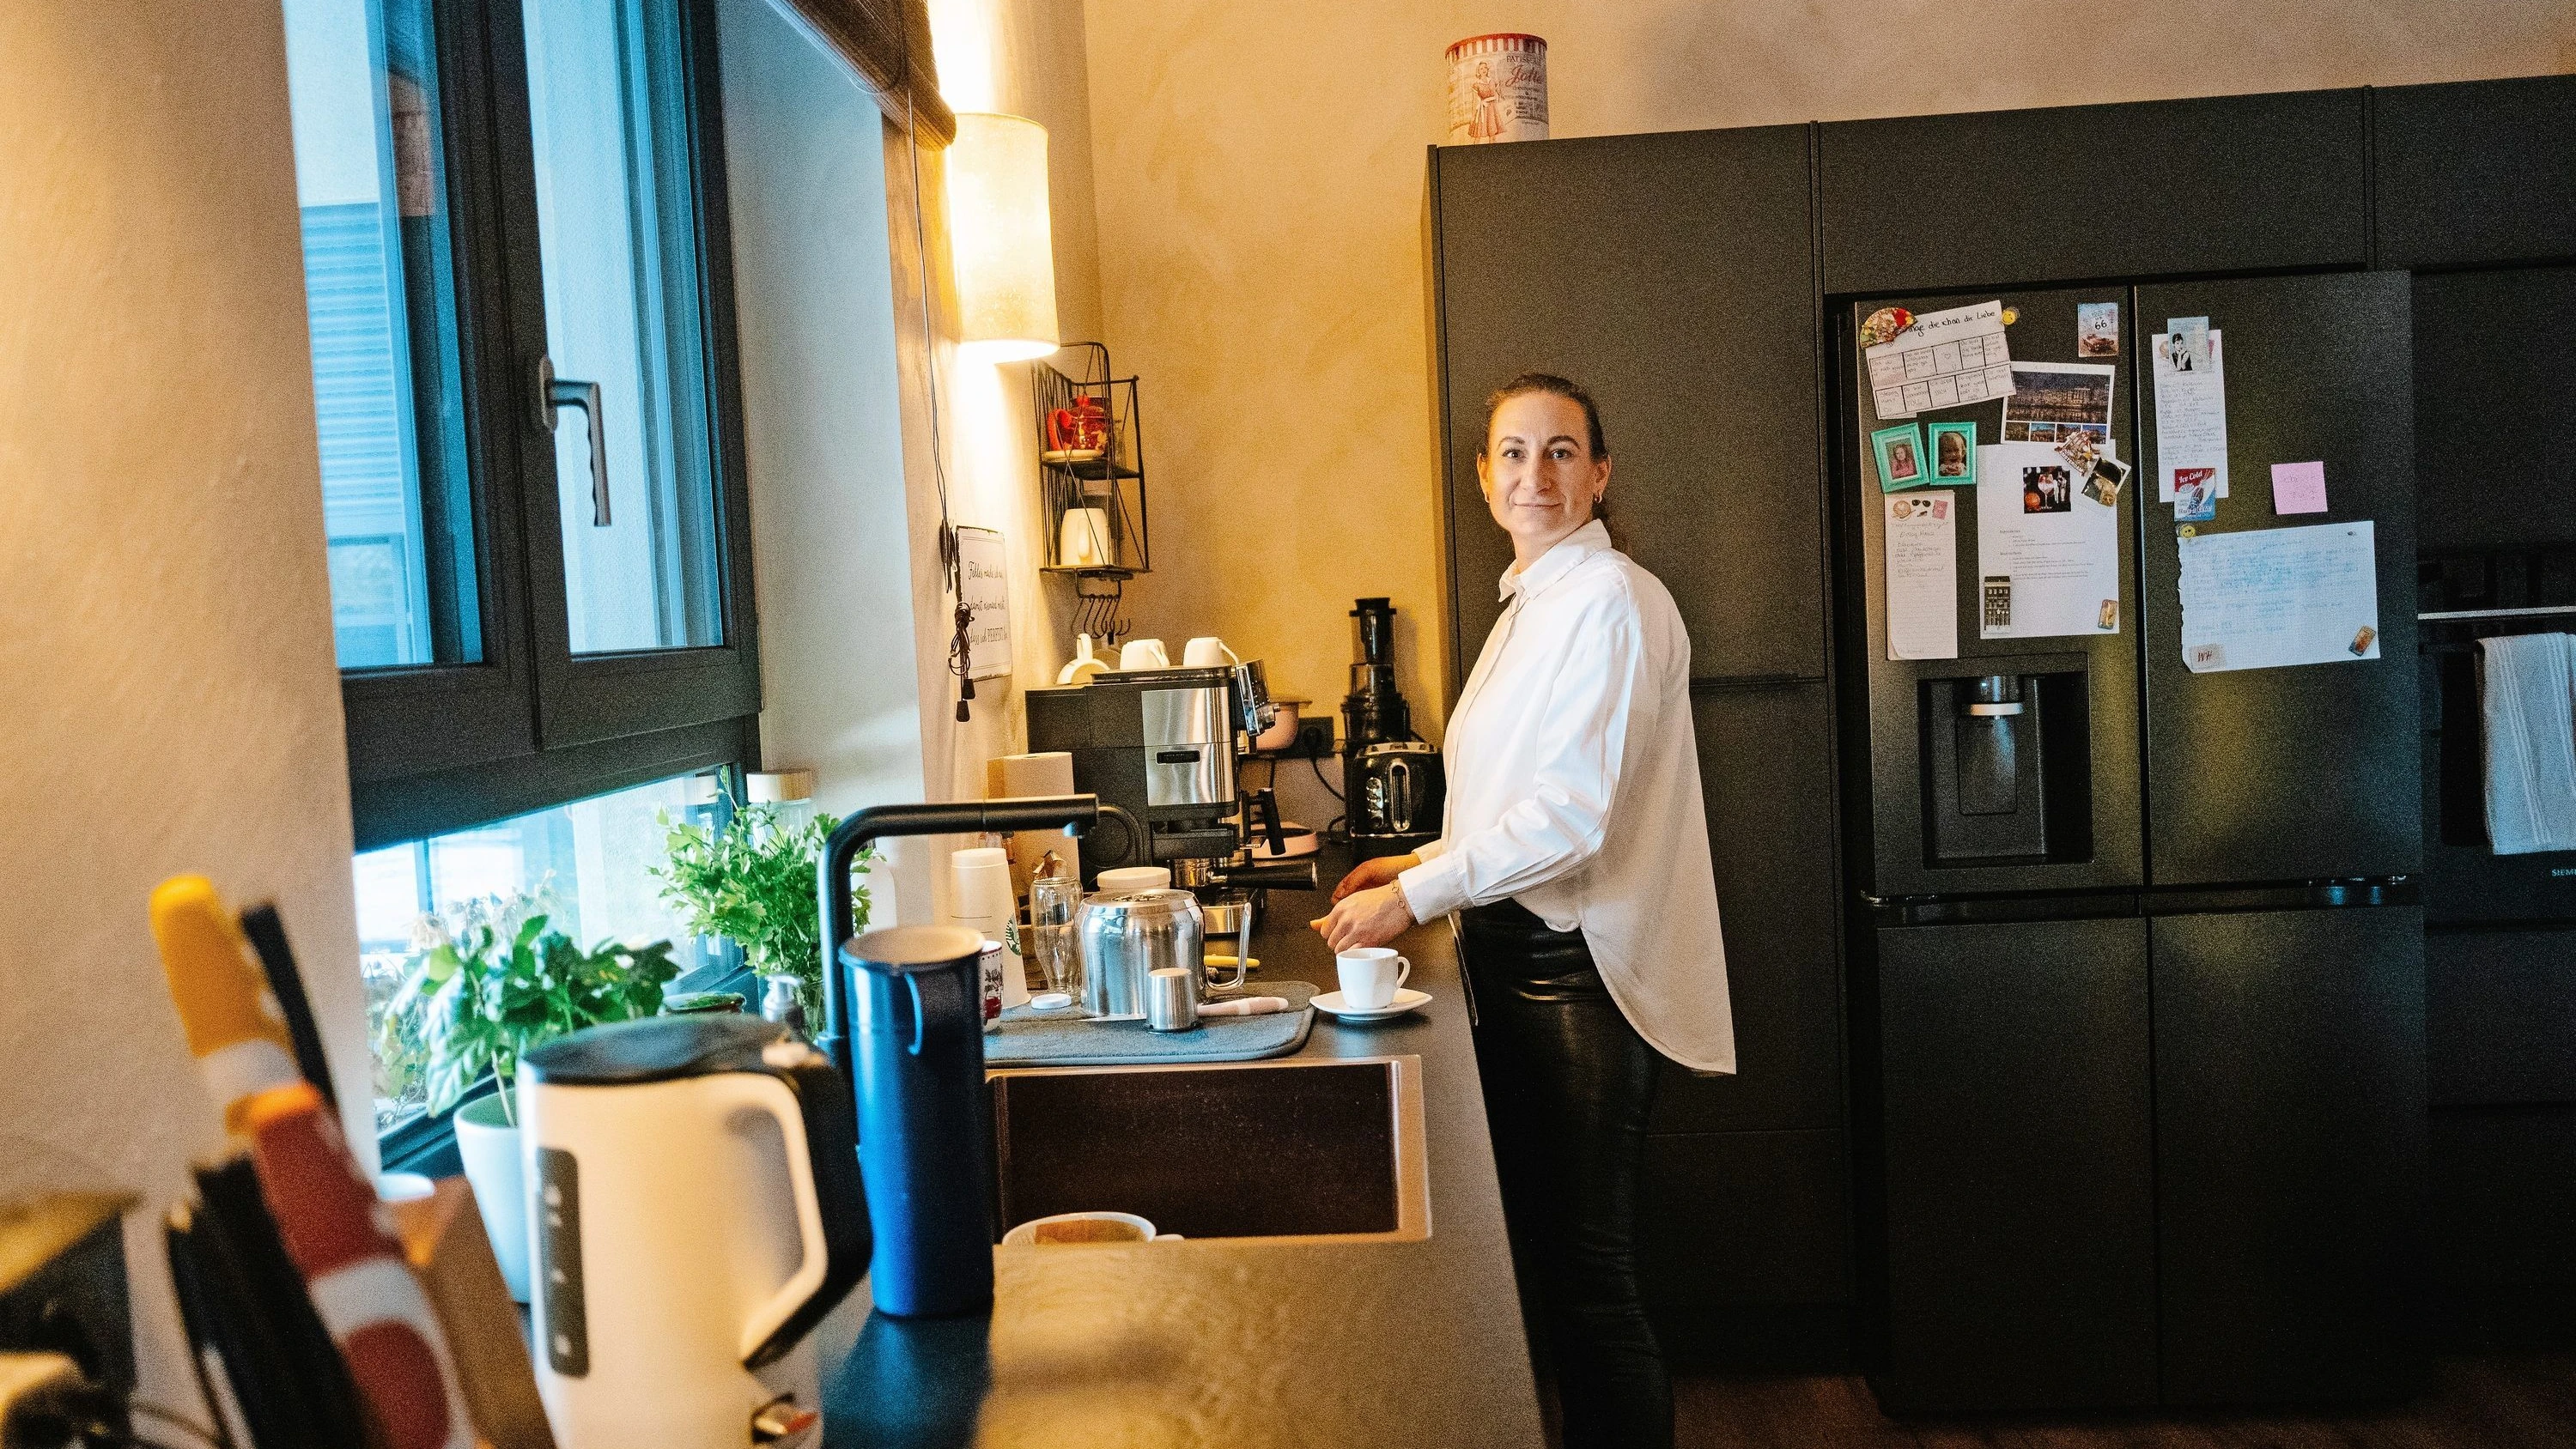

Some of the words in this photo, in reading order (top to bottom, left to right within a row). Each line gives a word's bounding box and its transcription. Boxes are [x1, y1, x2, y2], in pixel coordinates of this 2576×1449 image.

[1977, 311, 1996, 320] Liebe
[2095, 320, 2107, 330] 66
[2190, 470, 2203, 481] Cold
